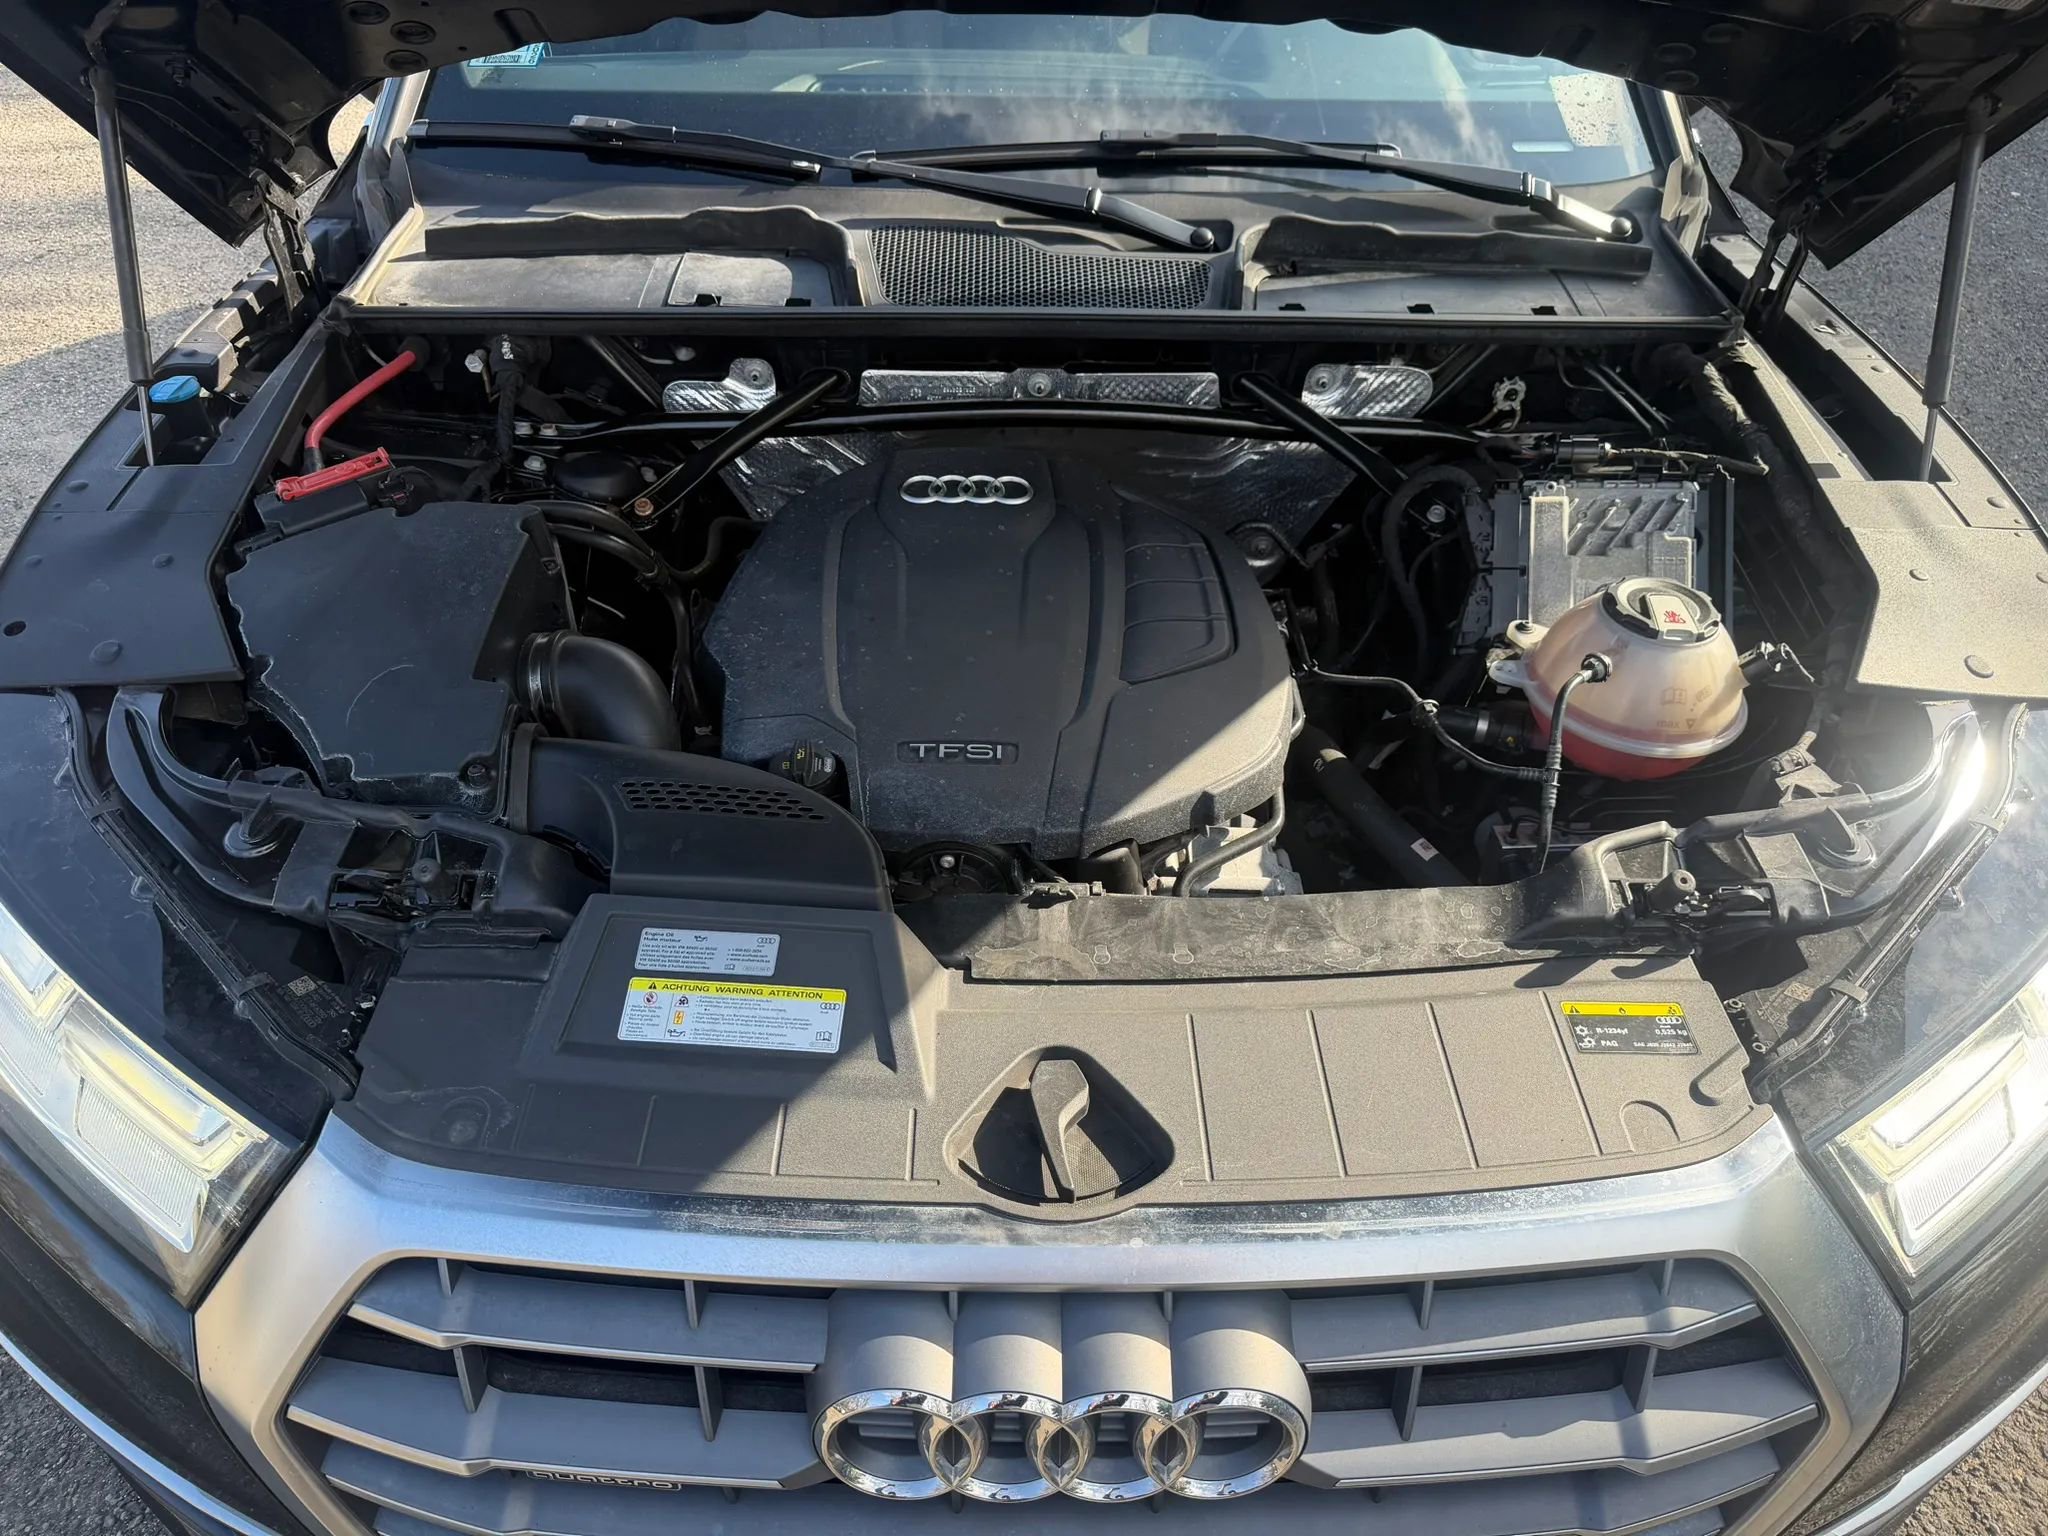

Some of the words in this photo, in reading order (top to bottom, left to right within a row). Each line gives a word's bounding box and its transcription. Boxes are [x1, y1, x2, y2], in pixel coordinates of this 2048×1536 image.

[909, 743, 1003, 759] TFSI
[661, 983, 710, 992] ACHTUNG
[715, 986, 764, 996] WARNING
[768, 989, 824, 999] ATTENTION
